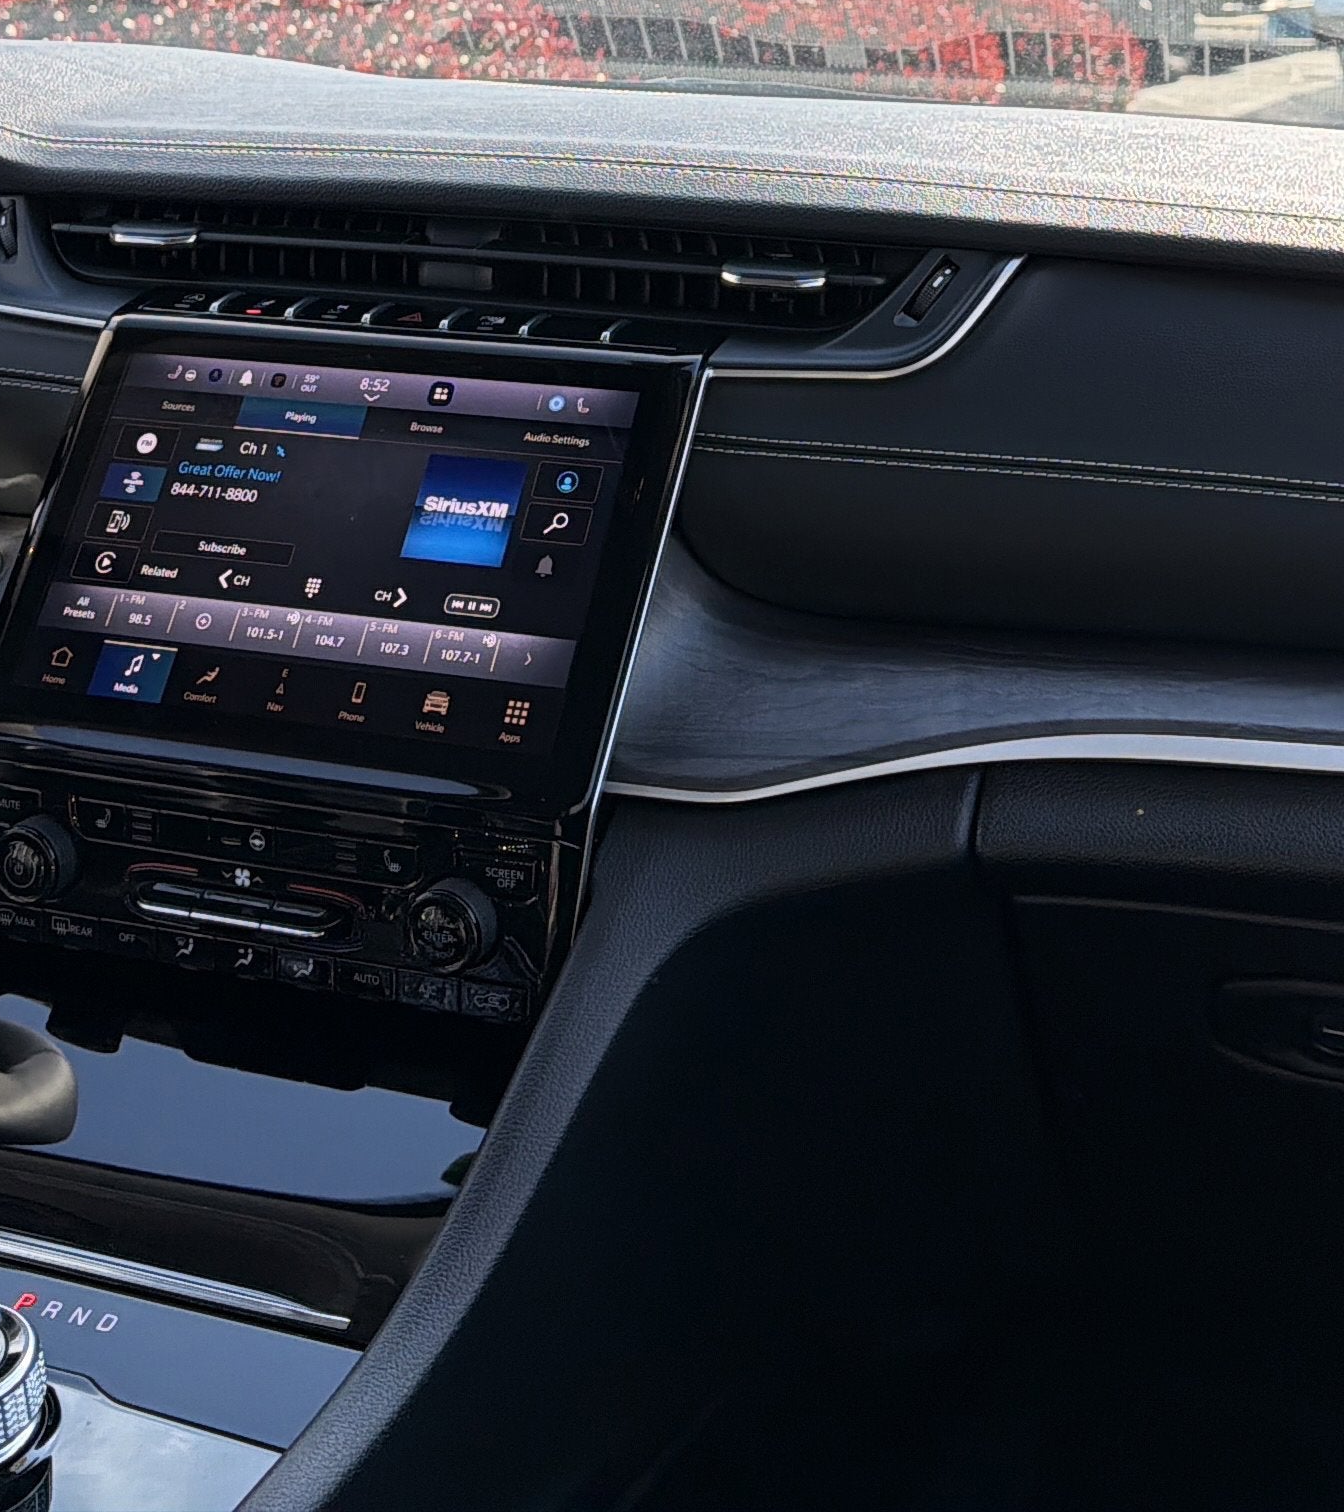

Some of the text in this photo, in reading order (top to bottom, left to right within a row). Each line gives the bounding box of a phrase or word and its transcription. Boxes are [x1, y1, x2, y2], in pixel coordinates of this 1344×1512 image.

[359, 376, 391, 393] 8:52
[161, 400, 196, 413] Sources
[284, 410, 317, 425] Playing
[409, 420, 444, 434] Browse
[522, 431, 591, 448] Audio Settings
[239, 441, 268, 457] Ch 1
[178, 461, 283, 483] Great Offer Now!
[170, 481, 259, 503] 844-711-8800
[423, 495, 510, 519] SiriusXM
[198, 540, 247, 556] Subscribe
[140, 564, 179, 579] Related
[233, 574, 251, 587] CH
[77, 595, 90, 607] All
[374, 589, 393, 602] CH
[63, 606, 97, 620] Presets
[128, 612, 153, 626] 98.5
[246, 625, 284, 640] 101.5-1
[314, 634, 345, 648] 104.7
[379, 642, 410, 656] 107.3
[440, 648, 481, 664] 107.7-1
[41, 673, 66, 686] Home
[113, 681, 139, 694] Media
[183, 690, 218, 705] Comfort
[266, 701, 284, 713] Nav
[337, 710, 366, 723] Phone
[414, 719, 445, 734] Vehicle
[498, 731, 521, 744] Apps
[485, 866, 525, 881] SCREEN
[496, 877, 517, 889] OFF
[15, 916, 36, 927] MAX
[70, 925, 93, 937] REAR
[118, 932, 136, 943] OFF
[353, 972, 380, 985] AUTO
[13, 1291, 119, 1332] P R N D
